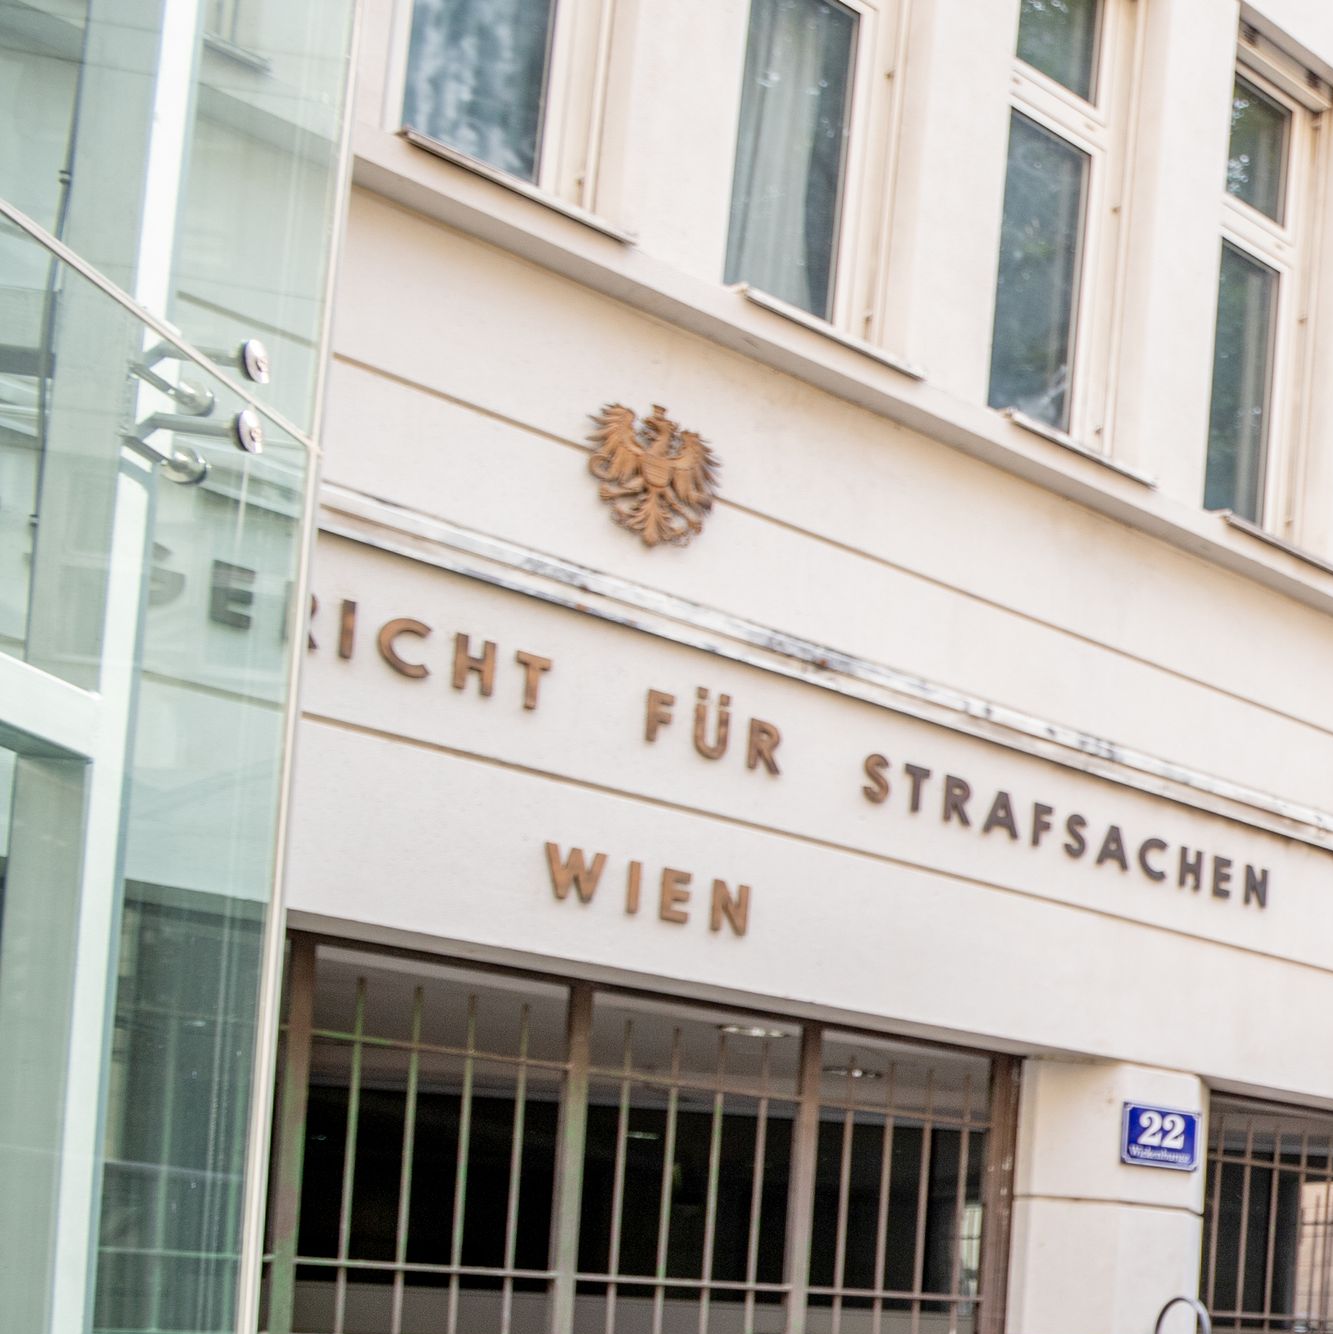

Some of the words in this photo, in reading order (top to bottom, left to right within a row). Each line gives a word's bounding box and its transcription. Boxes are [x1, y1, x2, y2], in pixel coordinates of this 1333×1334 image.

[645, 686, 782, 776] FÜR
[861, 753, 1271, 910] STRAFSACHEN
[545, 841, 752, 937] WIEN
[1137, 1110, 1185, 1150] 22
